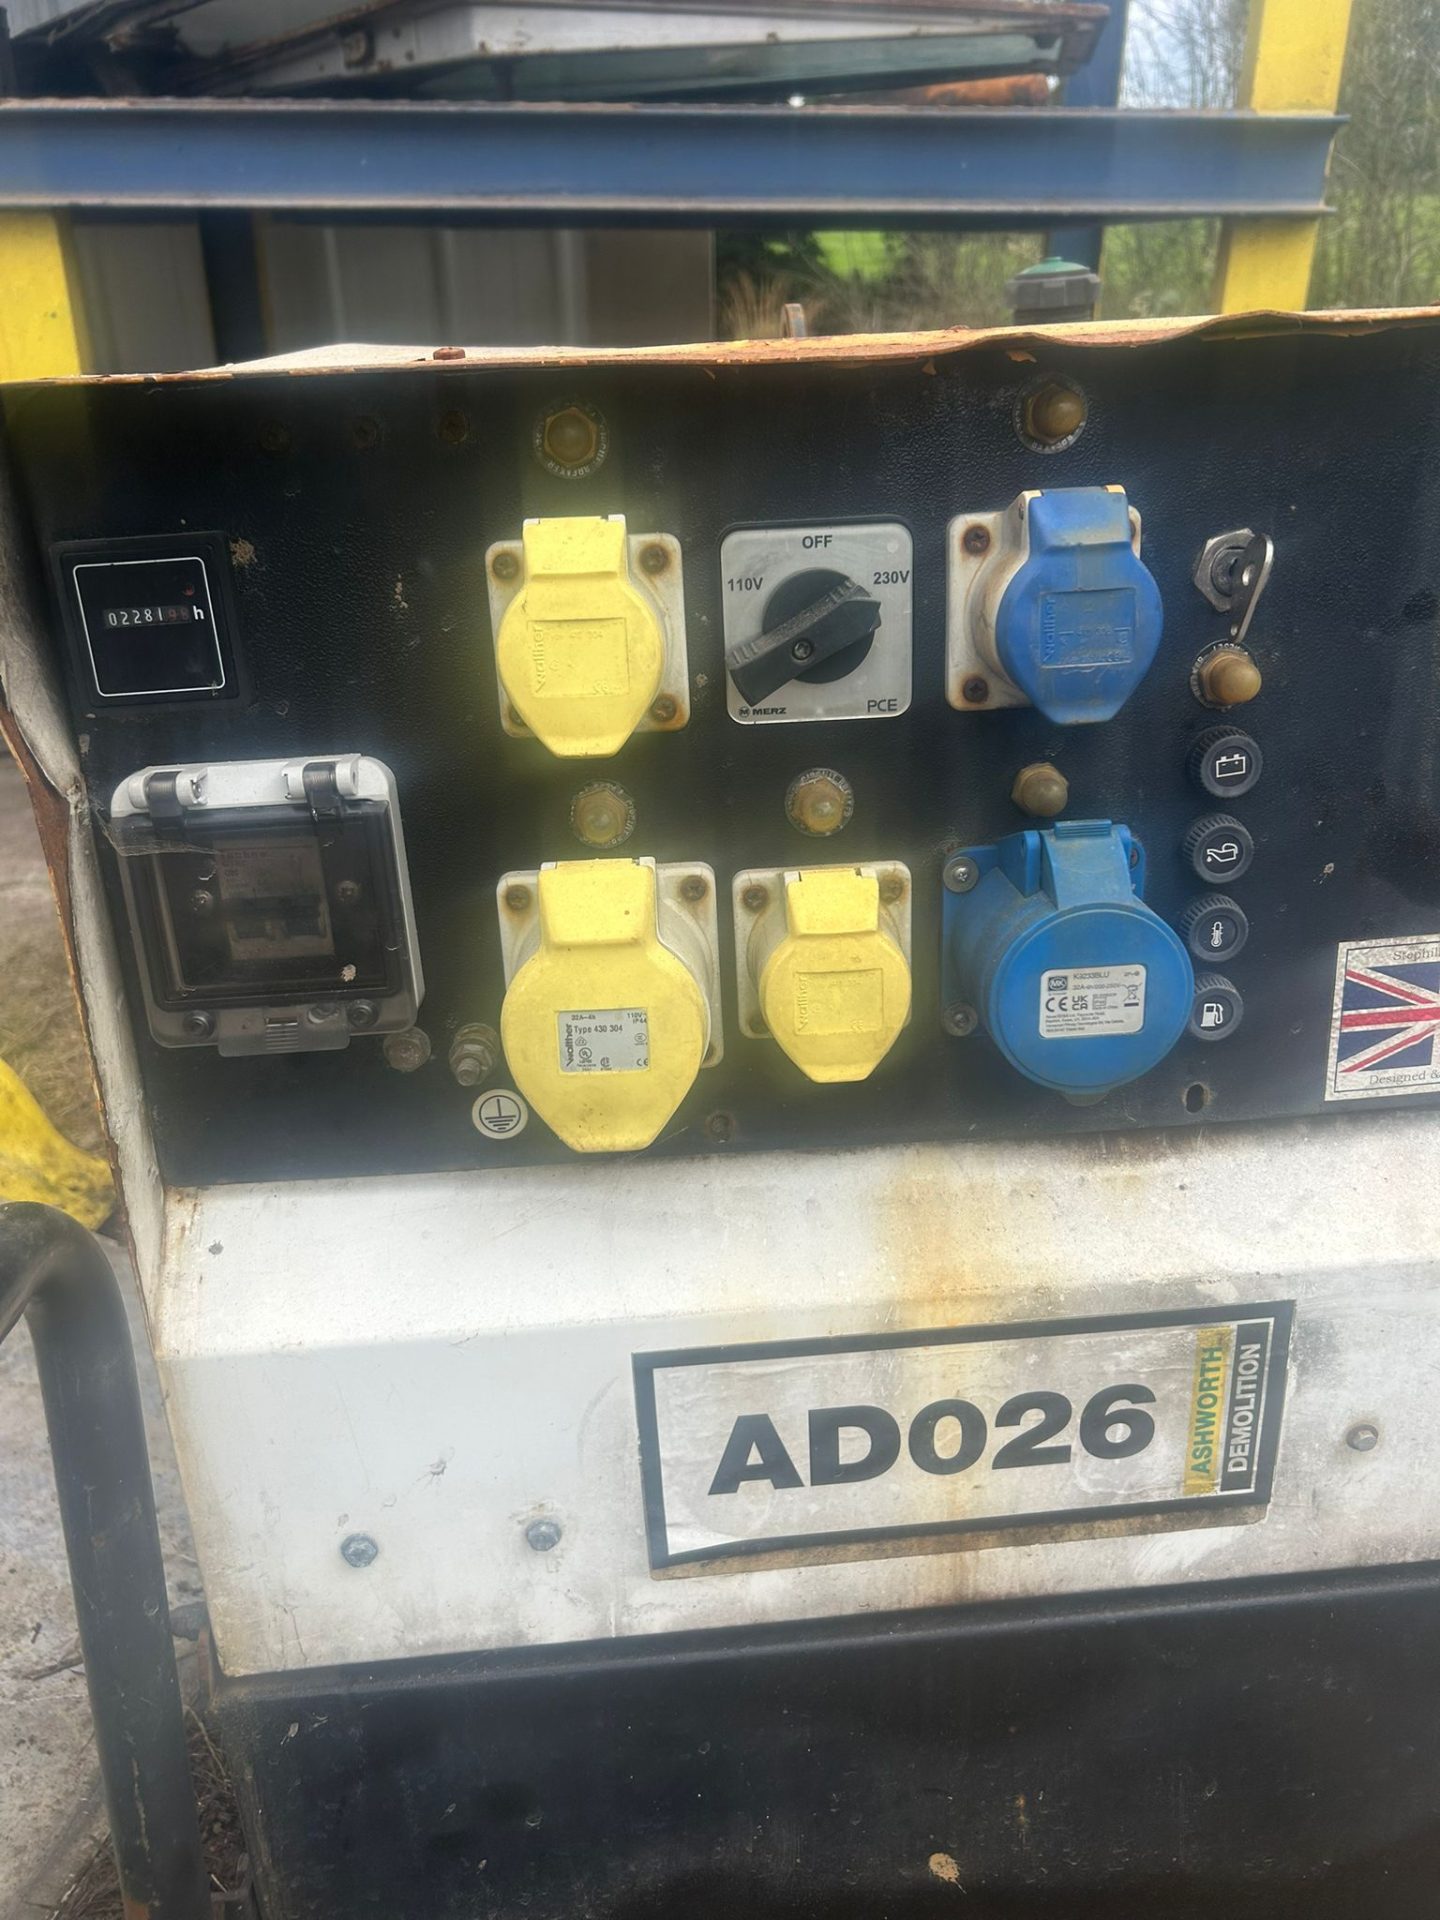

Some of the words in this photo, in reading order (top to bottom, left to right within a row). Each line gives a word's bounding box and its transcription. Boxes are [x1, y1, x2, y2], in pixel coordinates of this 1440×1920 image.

[802, 535, 833, 549] OFF
[728, 577, 764, 591] 110V
[873, 571, 910, 584] 230V
[193, 605, 205, 620] h
[752, 707, 787, 716] MERZ
[867, 699, 898, 712] PCE
[1045, 996, 1068, 1013] CE
[1071, 995, 1089, 1003] UK
[1071, 1003, 1089, 1011] CA
[574, 1025, 592, 1035] Type
[594, 1024, 608, 1033] 430
[609, 1023, 623, 1033] 304
[564, 1023, 575, 1067] walther
[1369, 1070, 1426, 1085] Designed
[1430, 1069, 1440, 1080] &
[1191, 1346, 1223, 1474] ASHWORTH
[1227, 1343, 1261, 1472] DEMOLITION
[707, 1383, 1157, 1495] AD026
